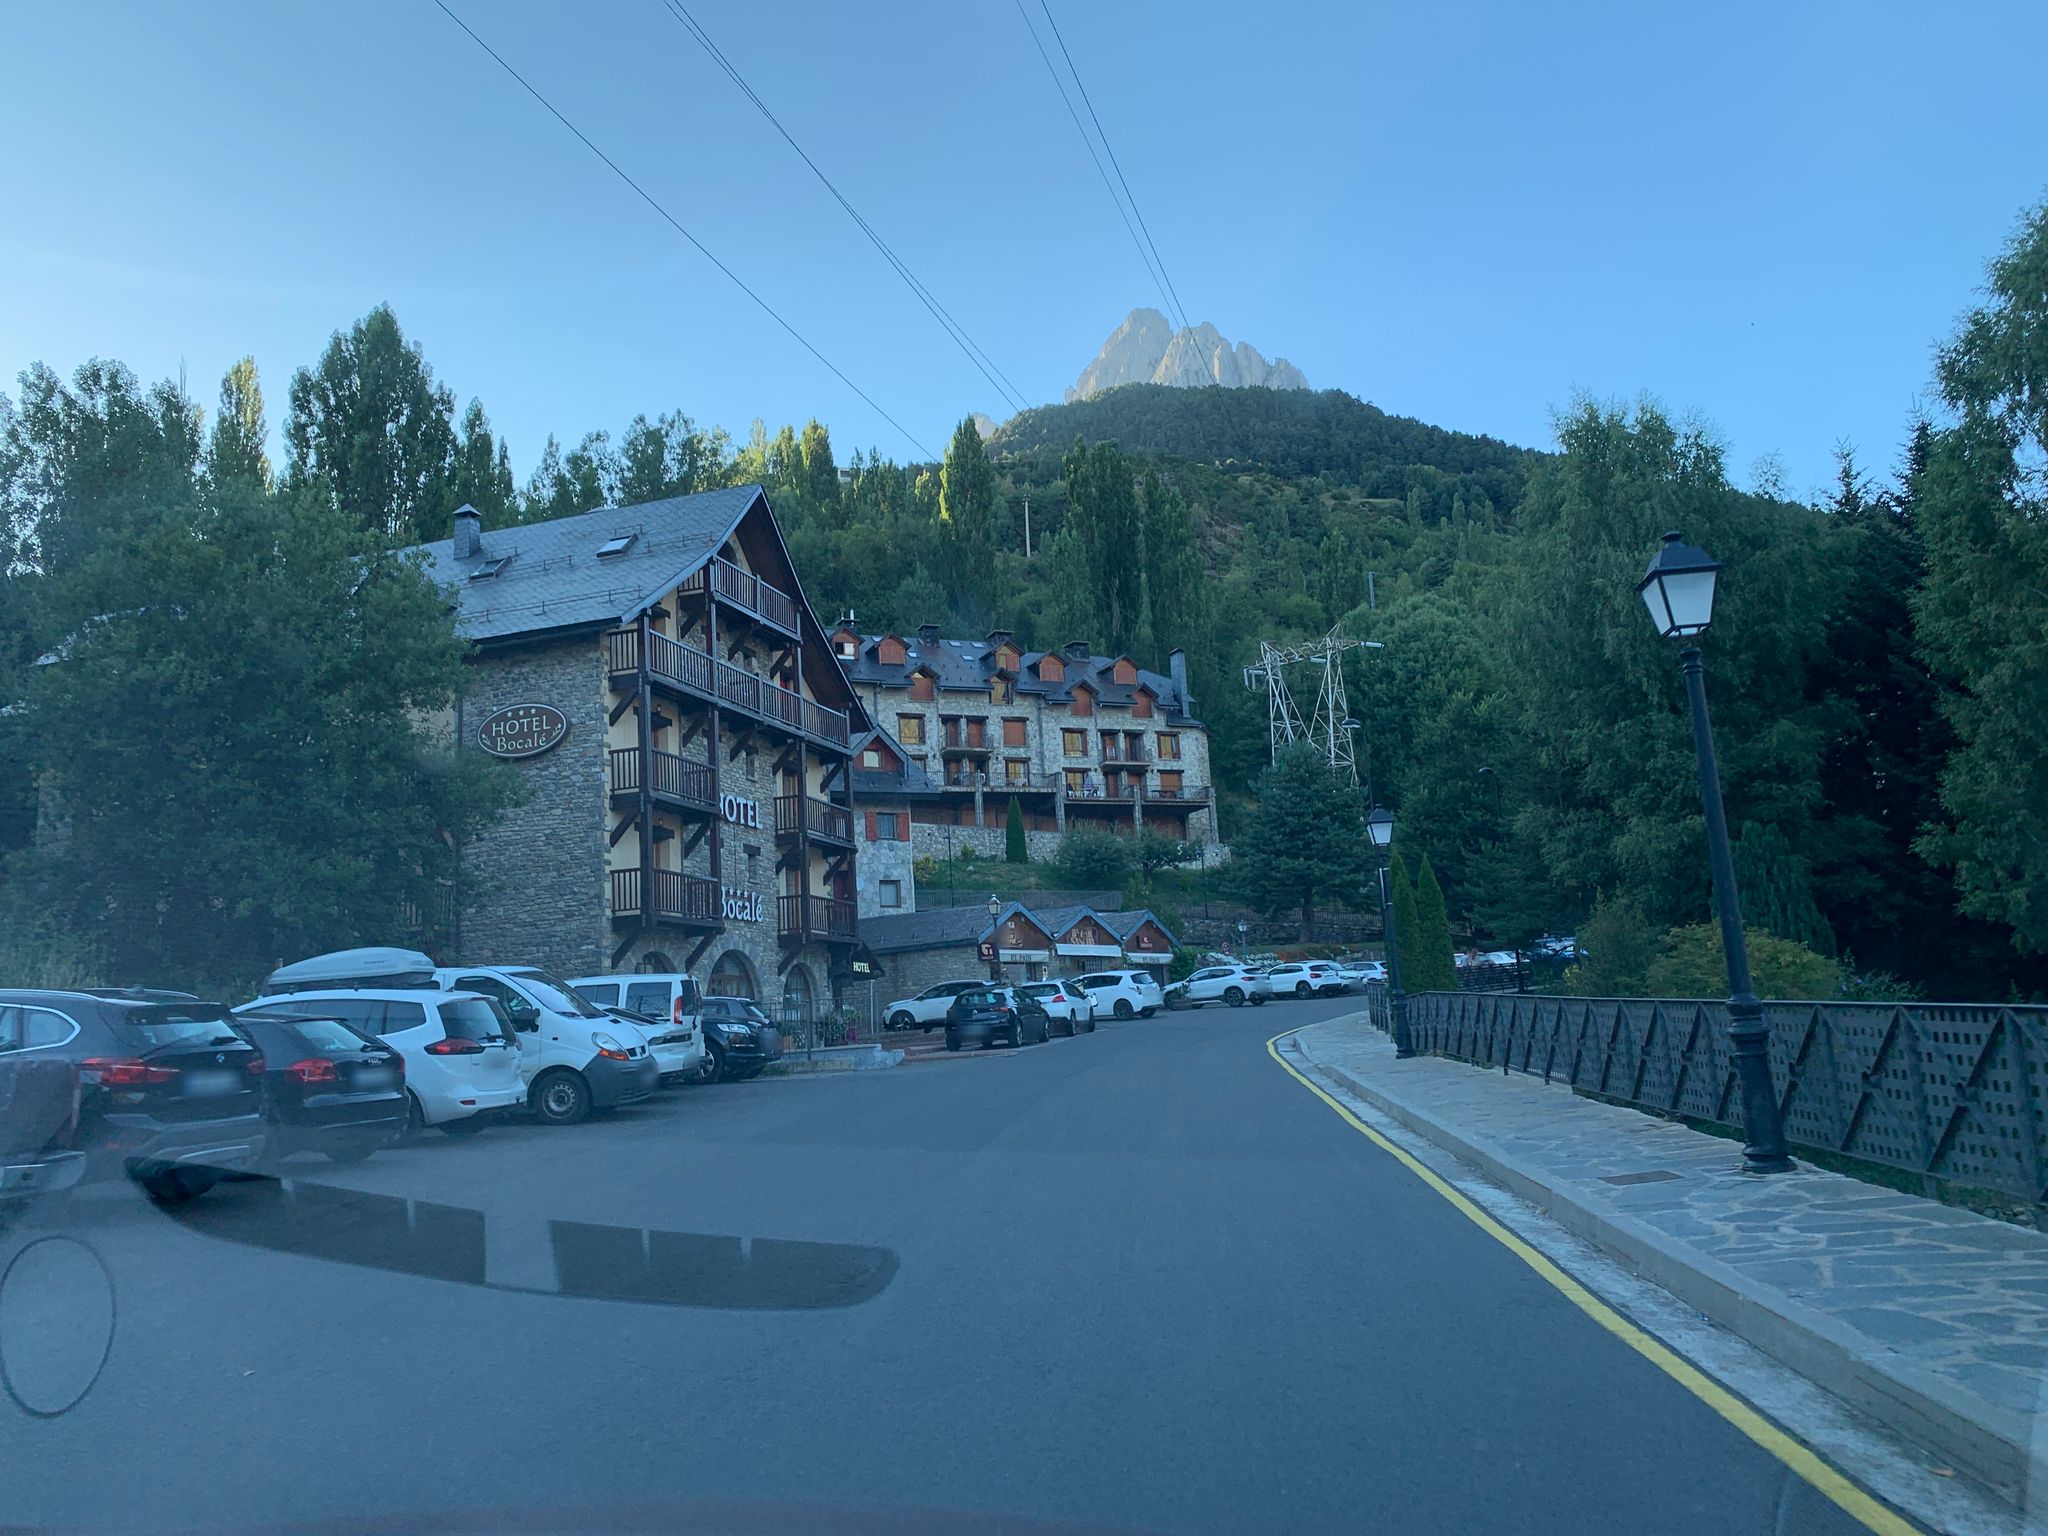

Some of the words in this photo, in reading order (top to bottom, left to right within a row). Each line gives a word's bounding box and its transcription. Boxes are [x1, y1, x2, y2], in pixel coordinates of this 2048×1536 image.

[492, 715, 551, 737] HOTEL
[497, 732, 547, 752] Bocalé
[852, 961, 871, 974] HOTEL
